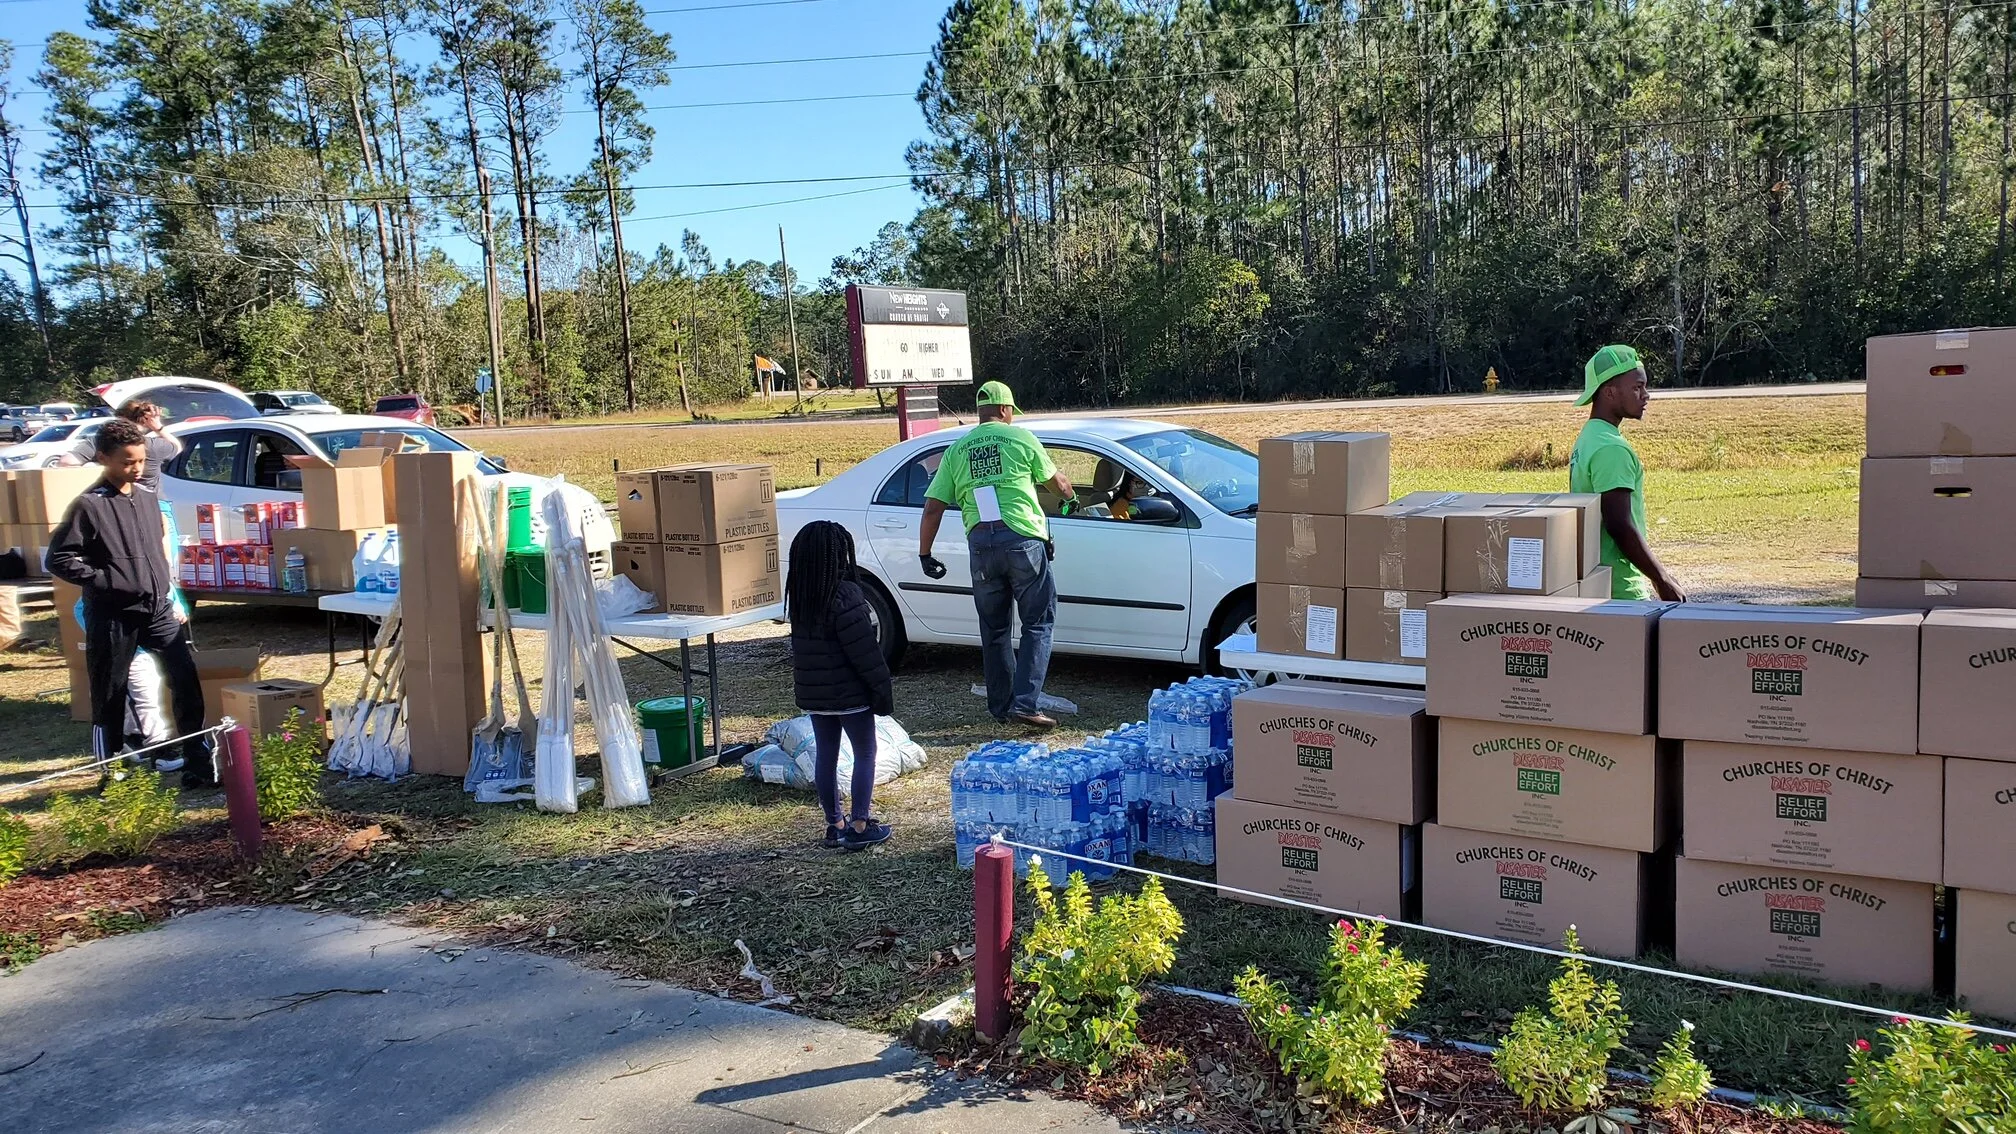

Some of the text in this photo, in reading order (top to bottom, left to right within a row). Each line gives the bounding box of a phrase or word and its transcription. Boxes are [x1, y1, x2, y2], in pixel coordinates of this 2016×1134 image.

[900, 342, 939, 353] GO HIGHER
[902, 368, 914, 379] AM
[931, 368, 945, 378] WED
[958, 437, 984, 455] CHURCHES
[993, 435, 1012, 445] CHRIST
[971, 456, 1000, 470] RELIEF
[972, 466, 1001, 479] EFFORT
[624, 532, 654, 540] PLASTIC BOTTLES
[725, 522, 770, 538] PLASTIC BOTTLES
[665, 533, 700, 541] PLASTIC BOTTLES
[731, 591, 775, 609] PLASTIC BOTTLES
[670, 603, 704, 613] PLASTIC BOTTLES
[1460, 621, 1605, 652] CHURCHES OF CHRIST
[1501, 636, 1552, 653] DISASTER
[1699, 635, 1869, 666] CHURCHES OF CHRIST
[1507, 655, 1546, 666] RELIEF
[1746, 653, 1808, 670] DISASTER
[1507, 664, 1546, 676] EFFORT
[1754, 671, 1800, 683] RELIEF
[1754, 682, 1800, 693] EFFORT
[1259, 717, 1378, 748] CHURCHES OF CHRIST
[1293, 730, 1336, 748] DISASTER
[1299, 747, 1331, 758] RELIEF
[1472, 738, 1616, 772] CHURCHES OF CHRIST
[1299, 756, 1331, 768] EFFORT
[1513, 752, 1565, 772] DISASTER
[1309, 767, 1322, 775] INC.
[1519, 771, 1558, 783] RELIEF
[1722, 760, 1894, 796] CHURCHES OF CHRIST
[1519, 780, 1558, 793] EFFORT
[1770, 776, 1832, 795] DISASTER
[1778, 796, 1825, 809] RELIEF
[1778, 806, 1825, 819] EFFORT
[1793, 820, 1811, 828] INC.
[1243, 819, 1365, 851] CHURCHES OF CHRIST
[1278, 832, 1322, 850] DISASTER
[1284, 849, 1317, 861] RELIEF
[1284, 858, 1317, 870] EFFORT
[1455, 847, 1597, 883] CHURCHES OF CHRIST
[1495, 860, 1547, 880] DISASTER
[1502, 879, 1540, 892] RELIEF
[1502, 888, 1540, 901] EFFORT
[1717, 877, 1887, 912] CHURCHES OF CHRIST
[1514, 901, 1529, 909] INC.
[1765, 892, 1826, 913] DISASTER
[1772, 911, 1819, 924] RELIEF
[1772, 921, 1819, 935] EFFORT
[1787, 935, 1804, 943] INC.
